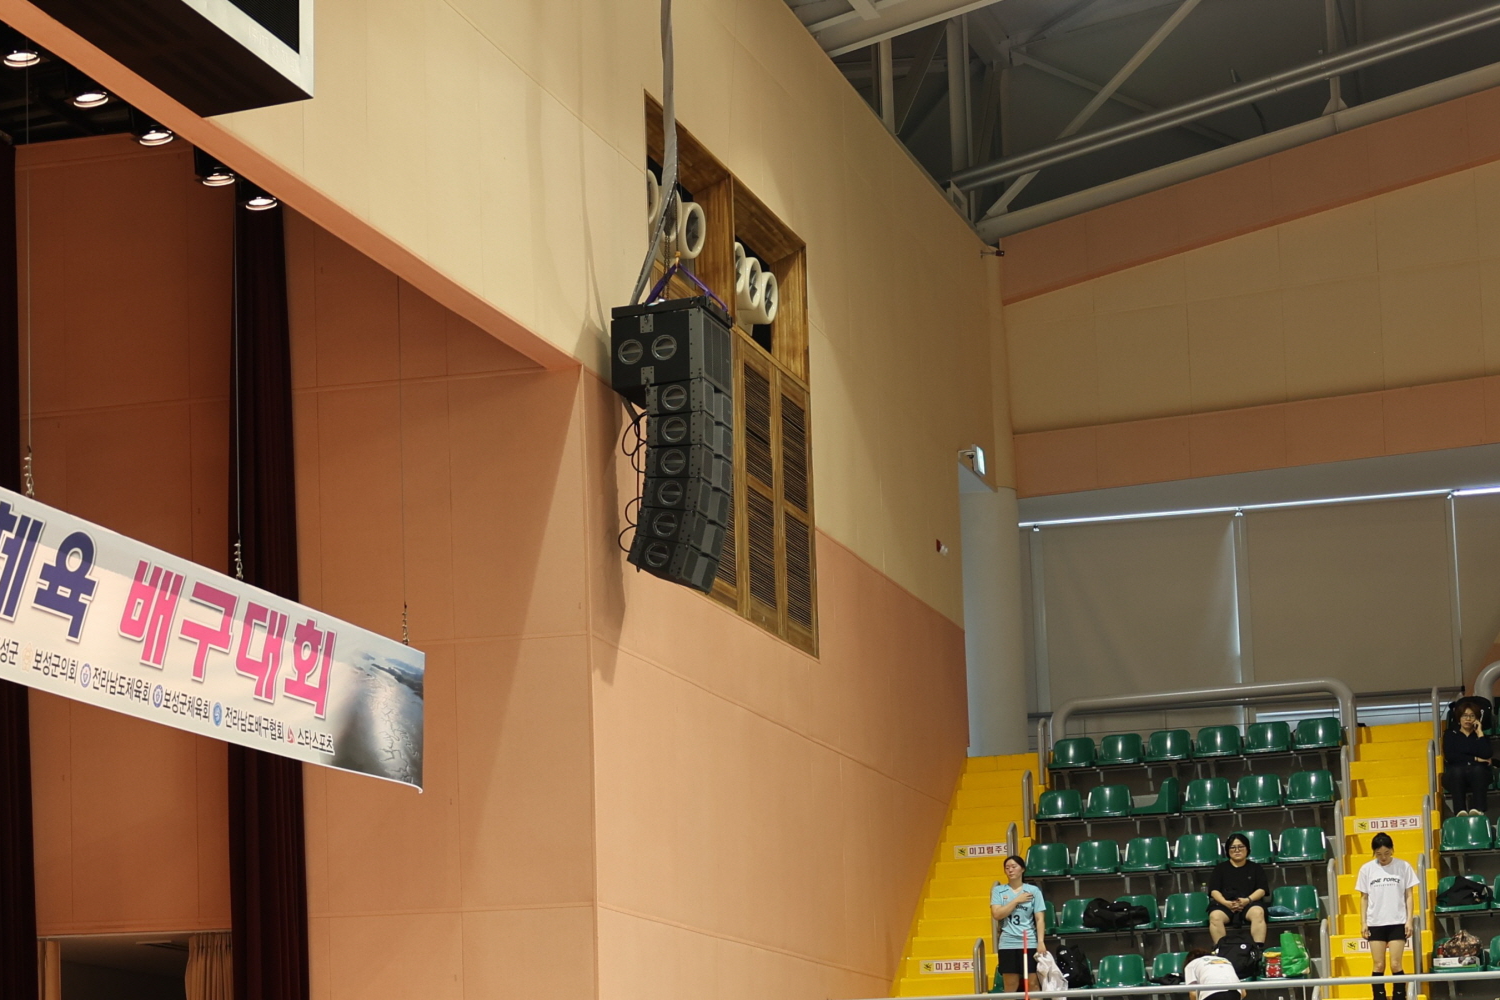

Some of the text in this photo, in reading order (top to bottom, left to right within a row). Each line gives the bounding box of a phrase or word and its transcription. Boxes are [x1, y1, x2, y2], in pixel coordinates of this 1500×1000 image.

[32, 649, 79, 685] 보성군의회
[92, 667, 152, 706] 전라남도체육회
[162, 689, 211, 722] 보성군체육회
[225, 706, 285, 743] 전라남도배구협회
[297, 729, 335, 755] 스타스포츠
[118, 560, 337, 719] 배구대회
